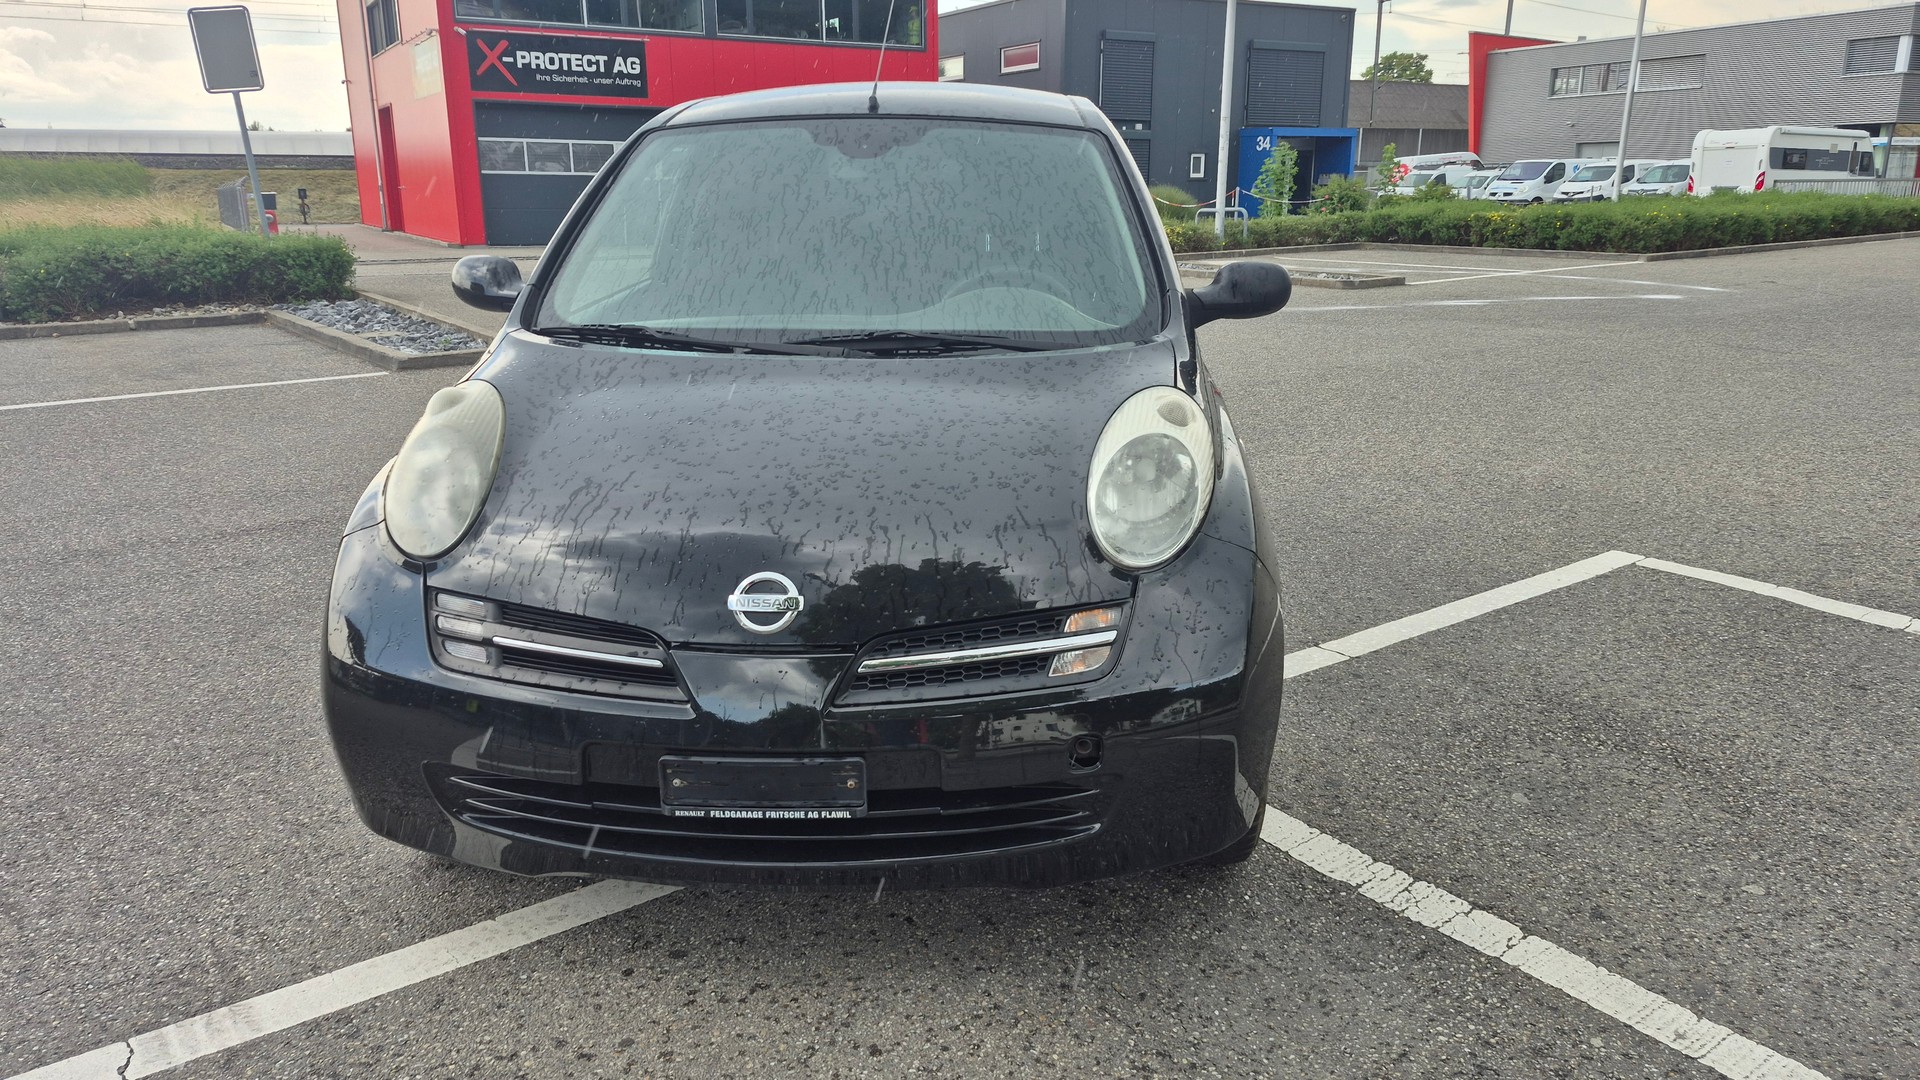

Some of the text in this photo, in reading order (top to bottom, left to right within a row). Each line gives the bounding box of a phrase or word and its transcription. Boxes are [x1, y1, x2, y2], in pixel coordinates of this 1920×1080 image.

[476, 38, 641, 86] X-PROTECT AG
[535, 73, 551, 82] Ihre
[552, 74, 589, 84] Sicherheit
[593, 77, 614, 85] unser
[615, 76, 642, 88] Auftrag
[1256, 135, 1271, 151] 34
[735, 598, 797, 609] NISSAN
[674, 810, 852, 819] RENAULT FELDGARAGE FRITSCHE AG FLAWIL
